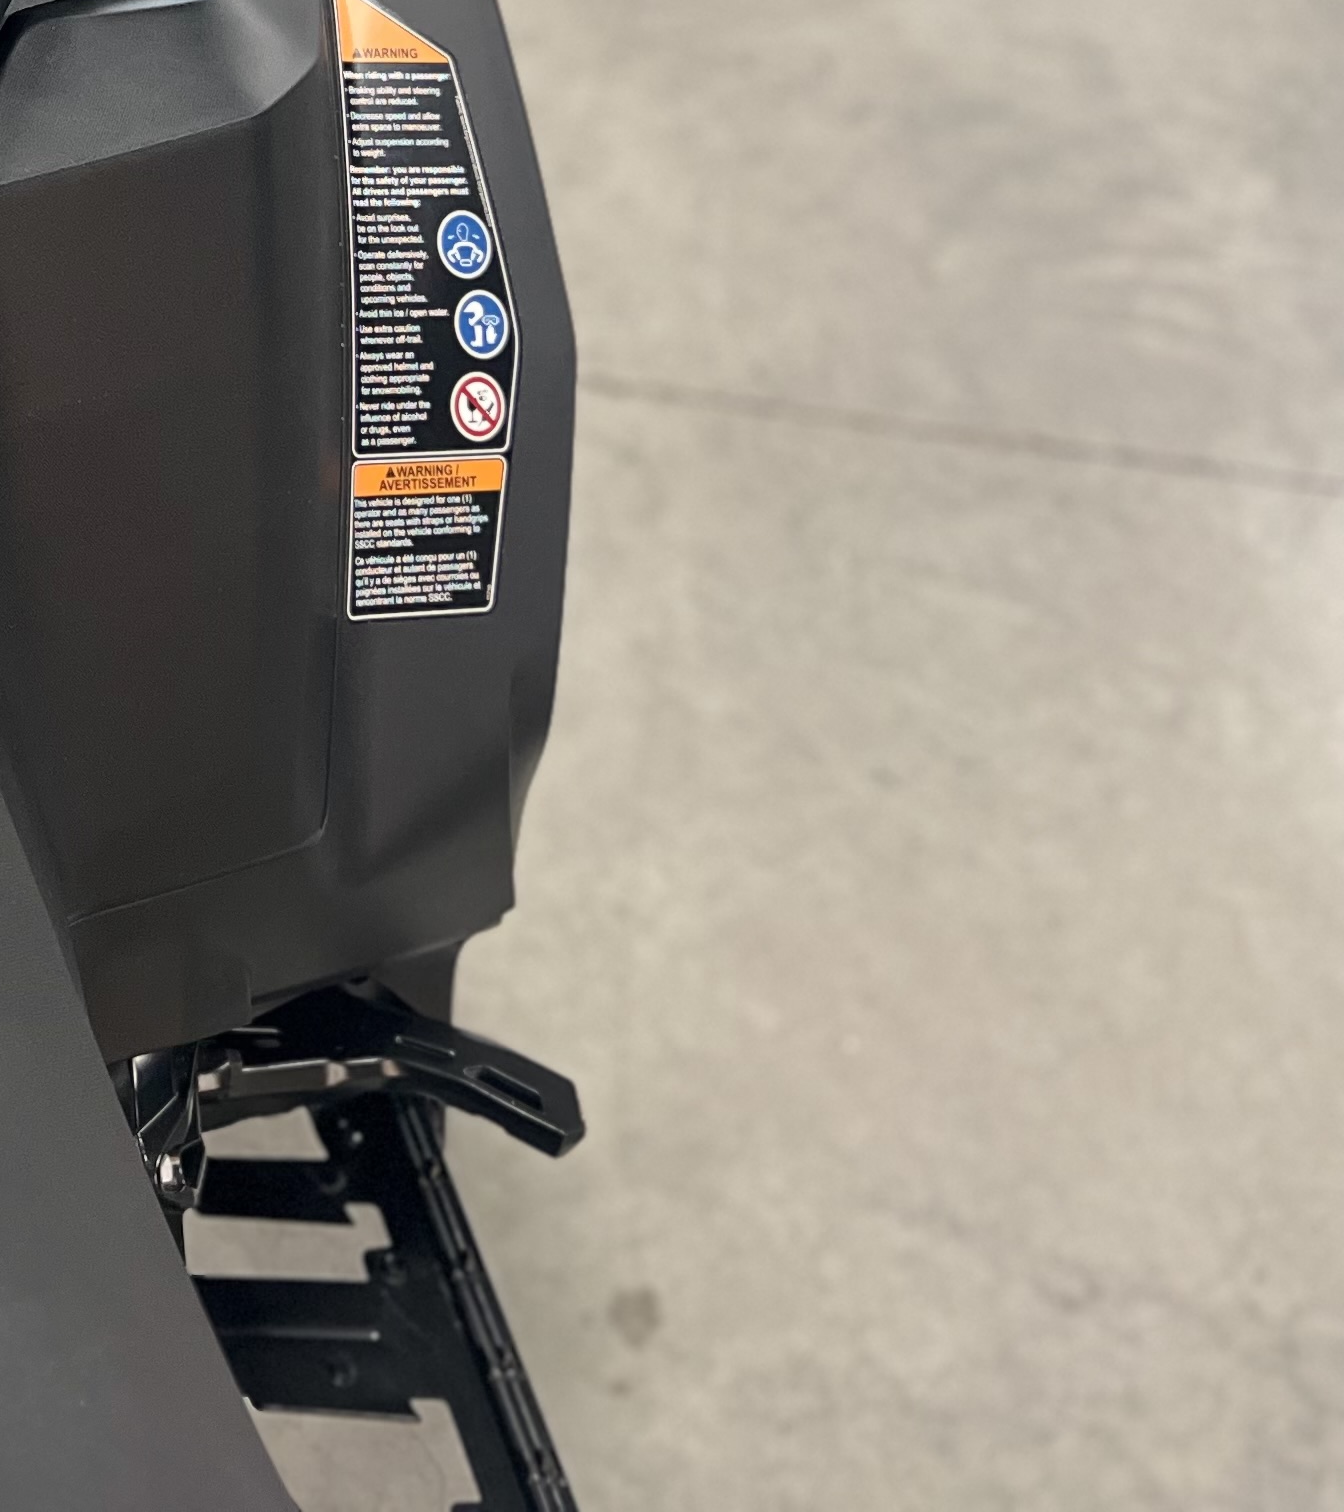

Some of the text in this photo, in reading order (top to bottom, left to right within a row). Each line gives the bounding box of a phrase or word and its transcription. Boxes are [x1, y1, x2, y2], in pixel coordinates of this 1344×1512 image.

[363, 48, 418, 58] WARNING
[396, 465, 452, 477] WARNING
[379, 476, 476, 491] AVERTISSEMENT
